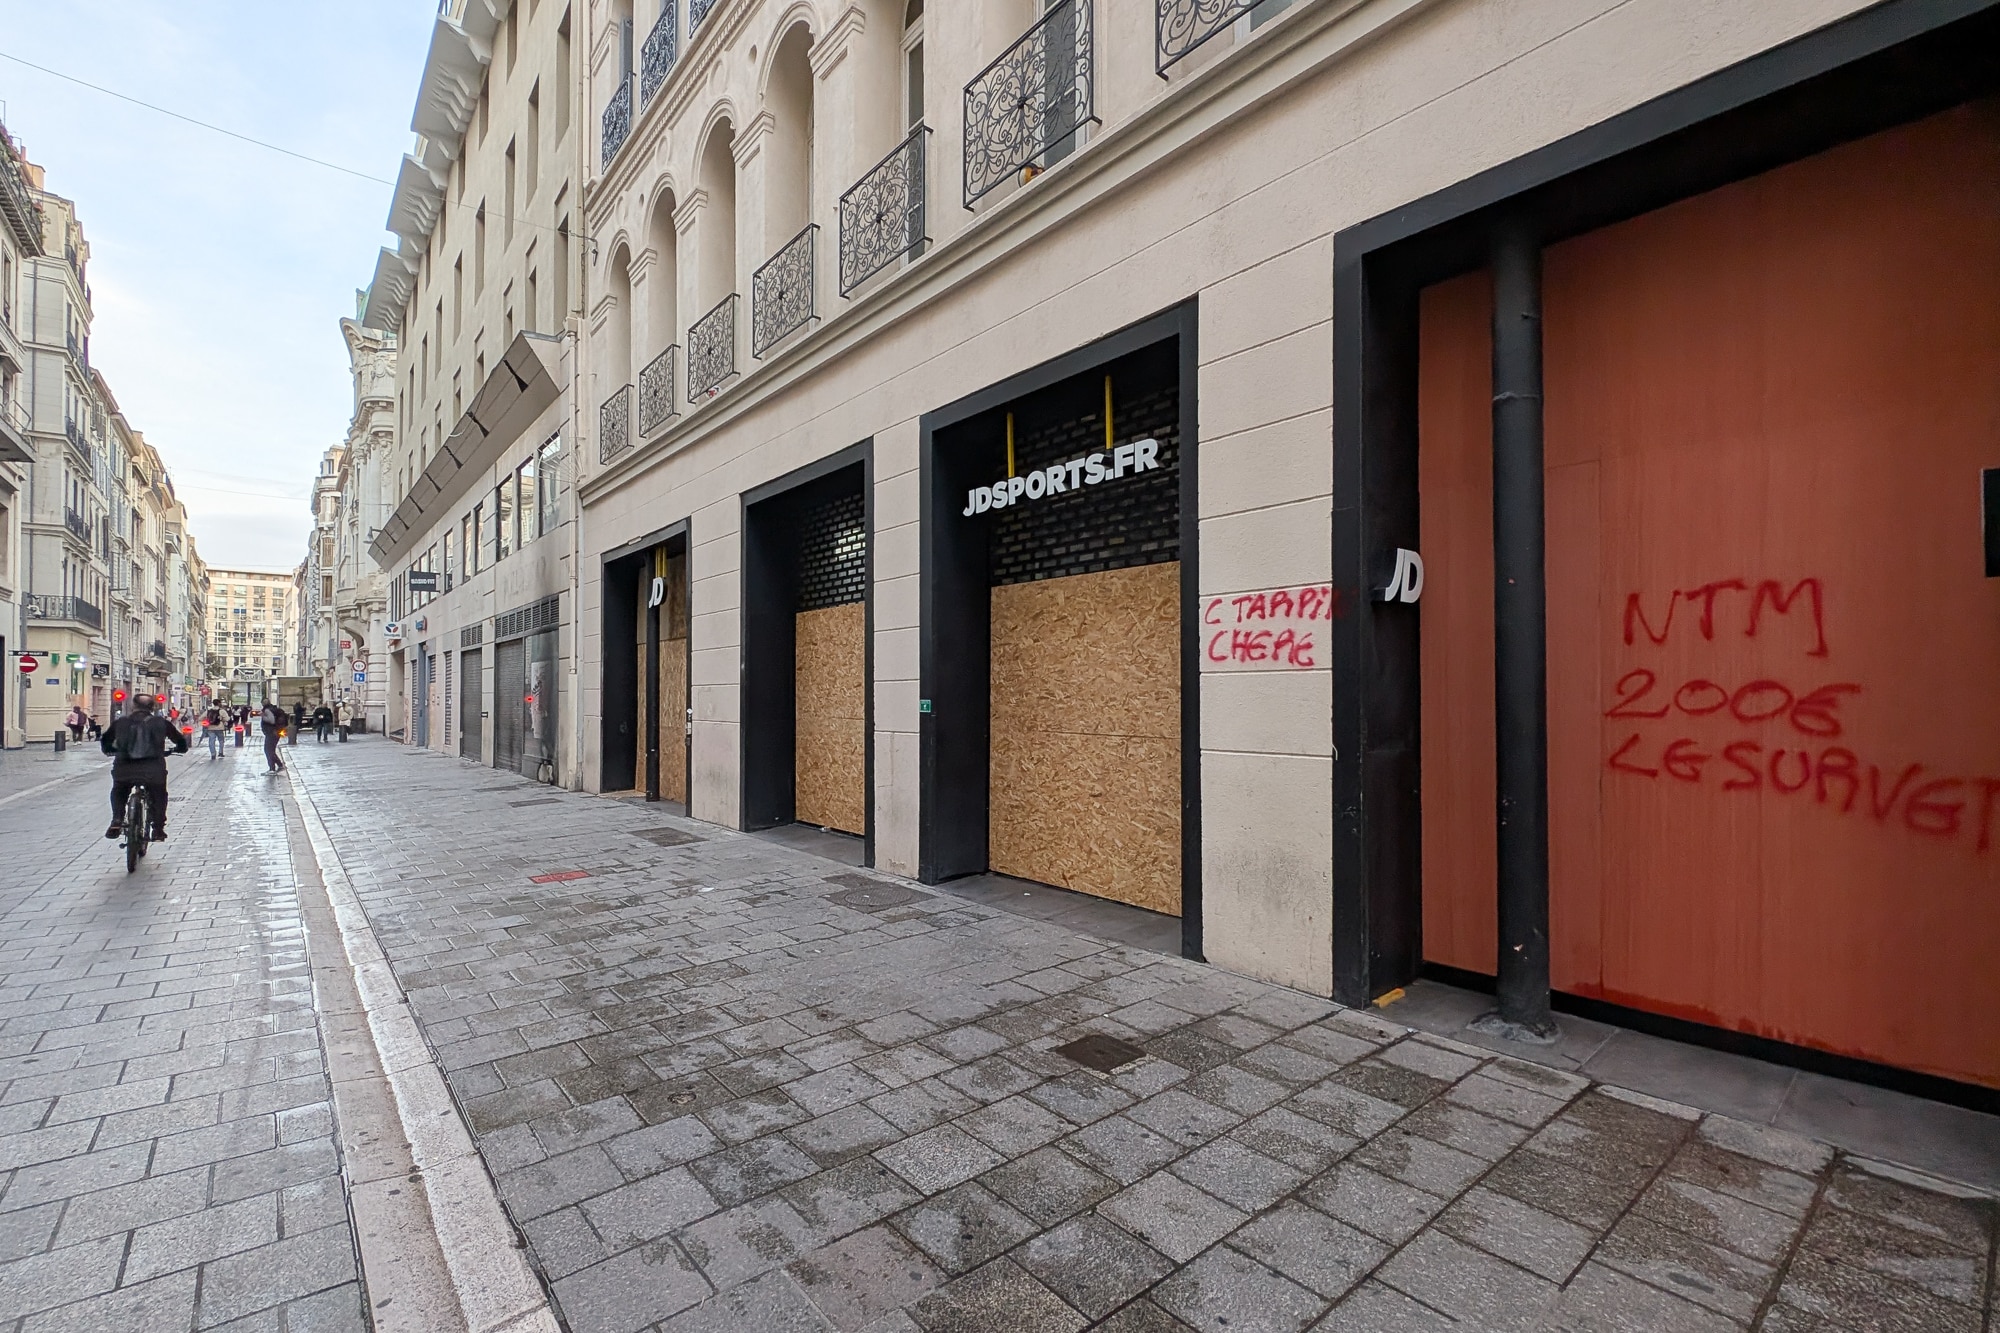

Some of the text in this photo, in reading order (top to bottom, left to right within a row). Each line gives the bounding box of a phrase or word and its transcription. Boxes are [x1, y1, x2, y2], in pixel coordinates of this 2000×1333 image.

[962, 438, 1159, 517] JDSPORTS.FR
[648, 576, 664, 609] JD
[1385, 548, 1424, 603] JD
[1204, 598, 1223, 625] C
[1623, 577, 1829, 657] NTM
